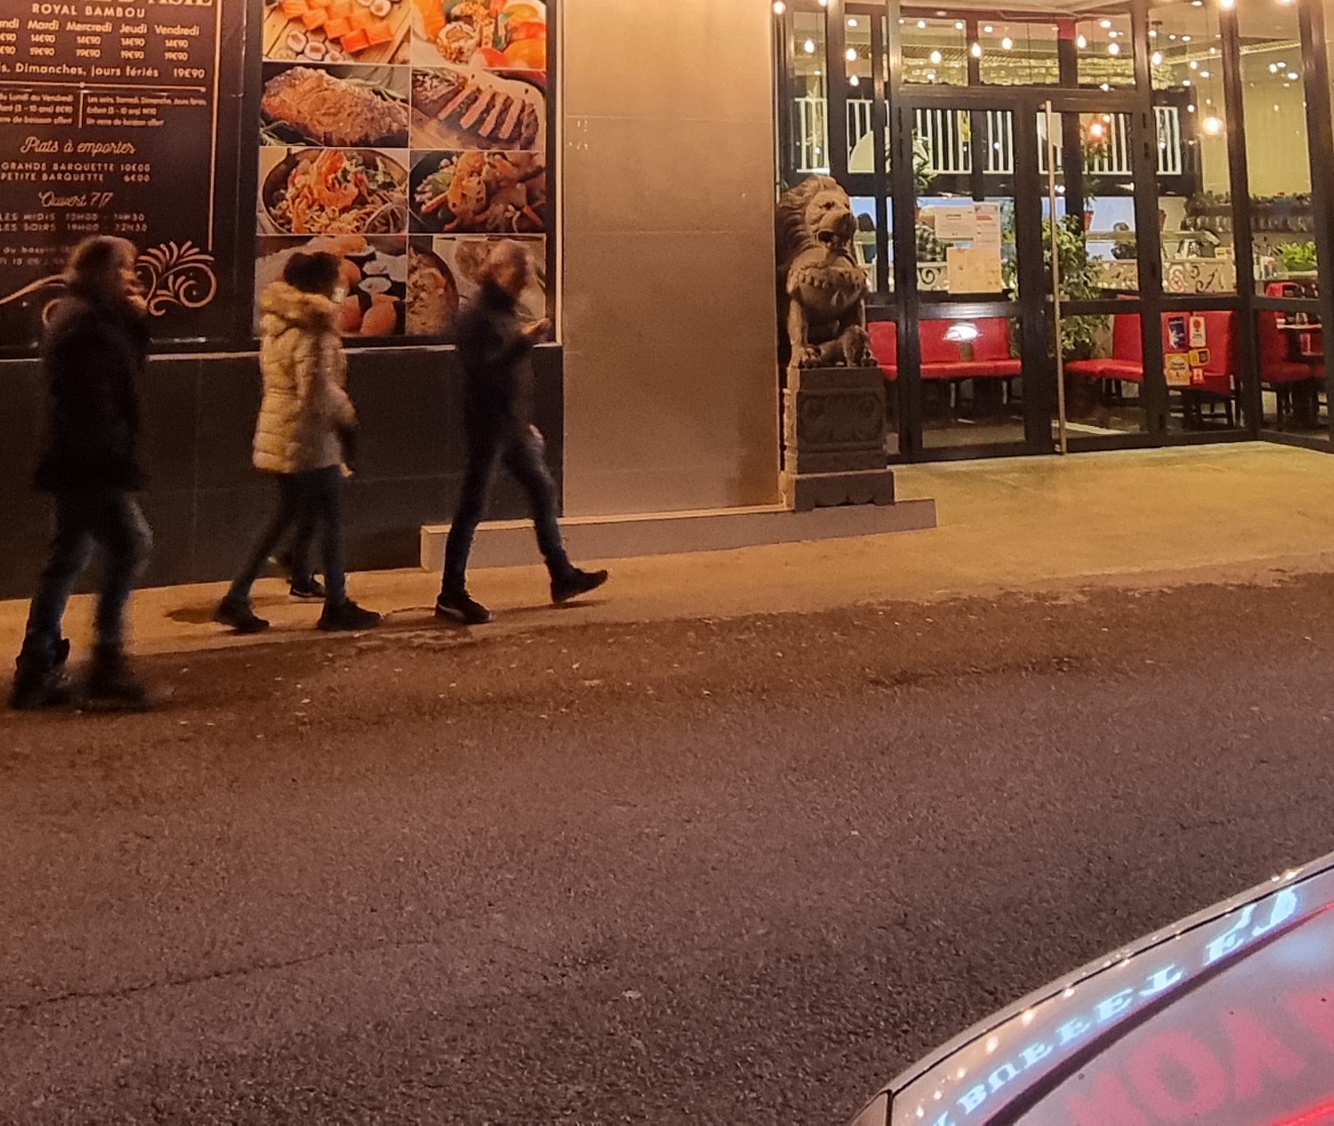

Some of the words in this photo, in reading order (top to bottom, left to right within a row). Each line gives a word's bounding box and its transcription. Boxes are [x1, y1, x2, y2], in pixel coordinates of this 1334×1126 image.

[32, 3, 78, 16] ROYAL
[85, 5, 146, 19] BAMBOU
[27, 19, 60, 31] Mardi
[66, 21, 113, 33] Mercredi
[119, 23, 147, 34] Jeudi
[155, 24, 200, 36] Vendredi
[20, 136, 59, 154] Plats
[63, 139, 74, 153] à
[76, 140, 136, 157] emporter
[0, 161, 47, 171] GRANDE
[52, 161, 115, 172] BARQUETTE
[0, 172, 37, 181] PETITE
[42, 173, 104, 182] BARQUETTE
[38, 190, 88, 208] Ouvert
